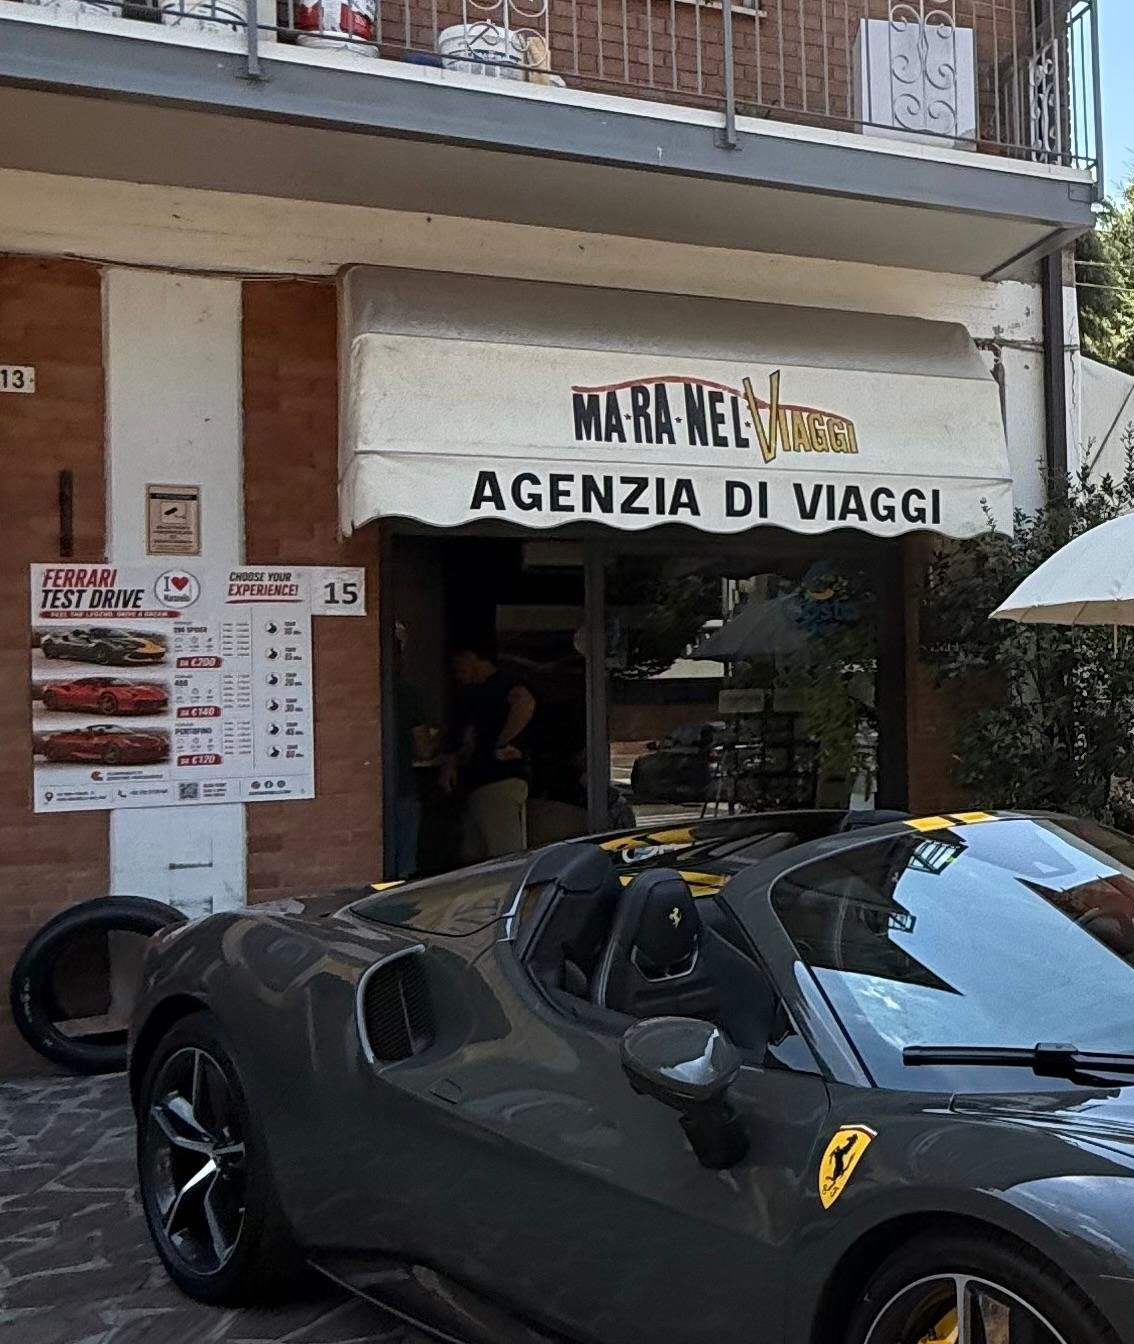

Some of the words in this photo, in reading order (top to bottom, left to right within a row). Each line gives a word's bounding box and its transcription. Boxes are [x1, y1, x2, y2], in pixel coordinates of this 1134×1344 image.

[1, 369, 25, 389] 13
[742, 369, 859, 464] VIAGGI
[470, 471, 701, 517] AGENZIA
[725, 480, 769, 519] DI
[793, 482, 941, 524] VIAGGI
[42, 568, 118, 588] FERRARI
[229, 571, 265, 582] CHOOSE
[268, 571, 292, 582] YOUR
[41, 589, 87, 609] TEST
[89, 589, 145, 609] DRIVE
[228, 583, 299, 597] EXPERIENCE!
[324, 582, 358, 605] 15
